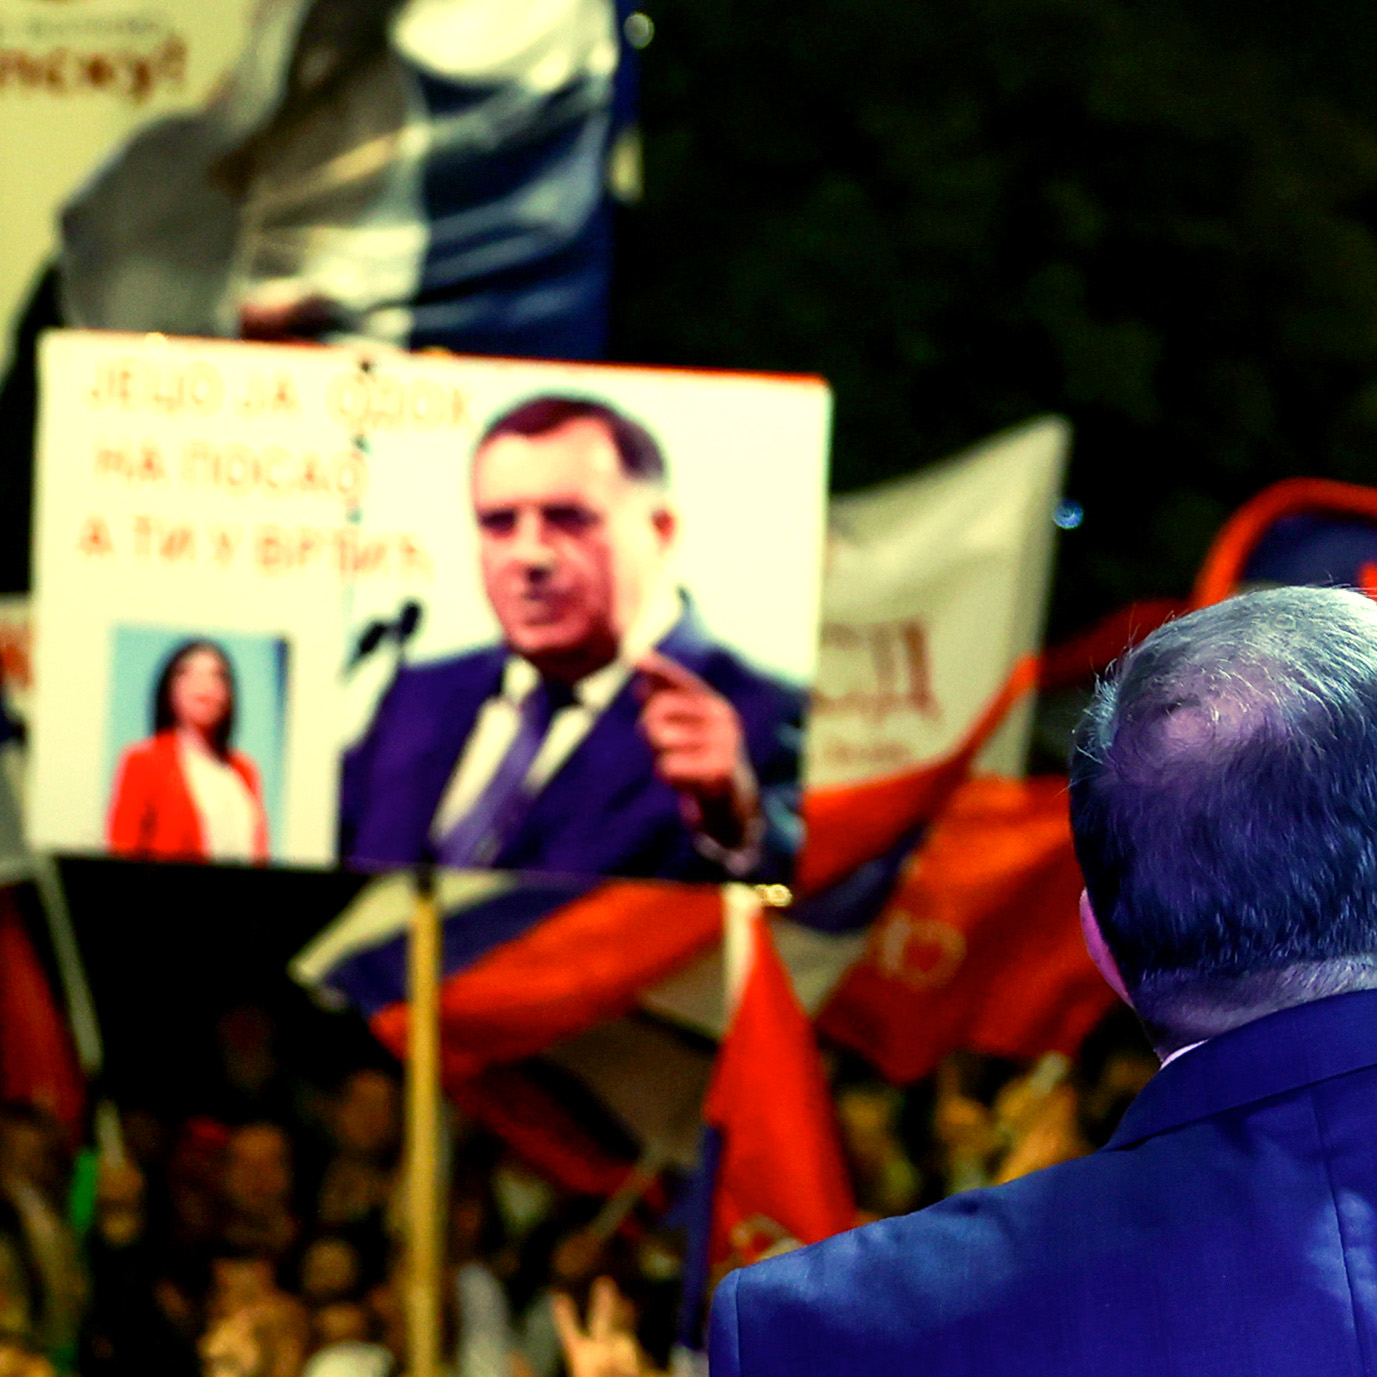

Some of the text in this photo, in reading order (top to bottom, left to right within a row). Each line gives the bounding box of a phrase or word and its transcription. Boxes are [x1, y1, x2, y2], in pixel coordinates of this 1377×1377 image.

[182, 441, 367, 497] ПОСАО
[77, 513, 114, 560] А
[132, 515, 195, 564] ТИ
